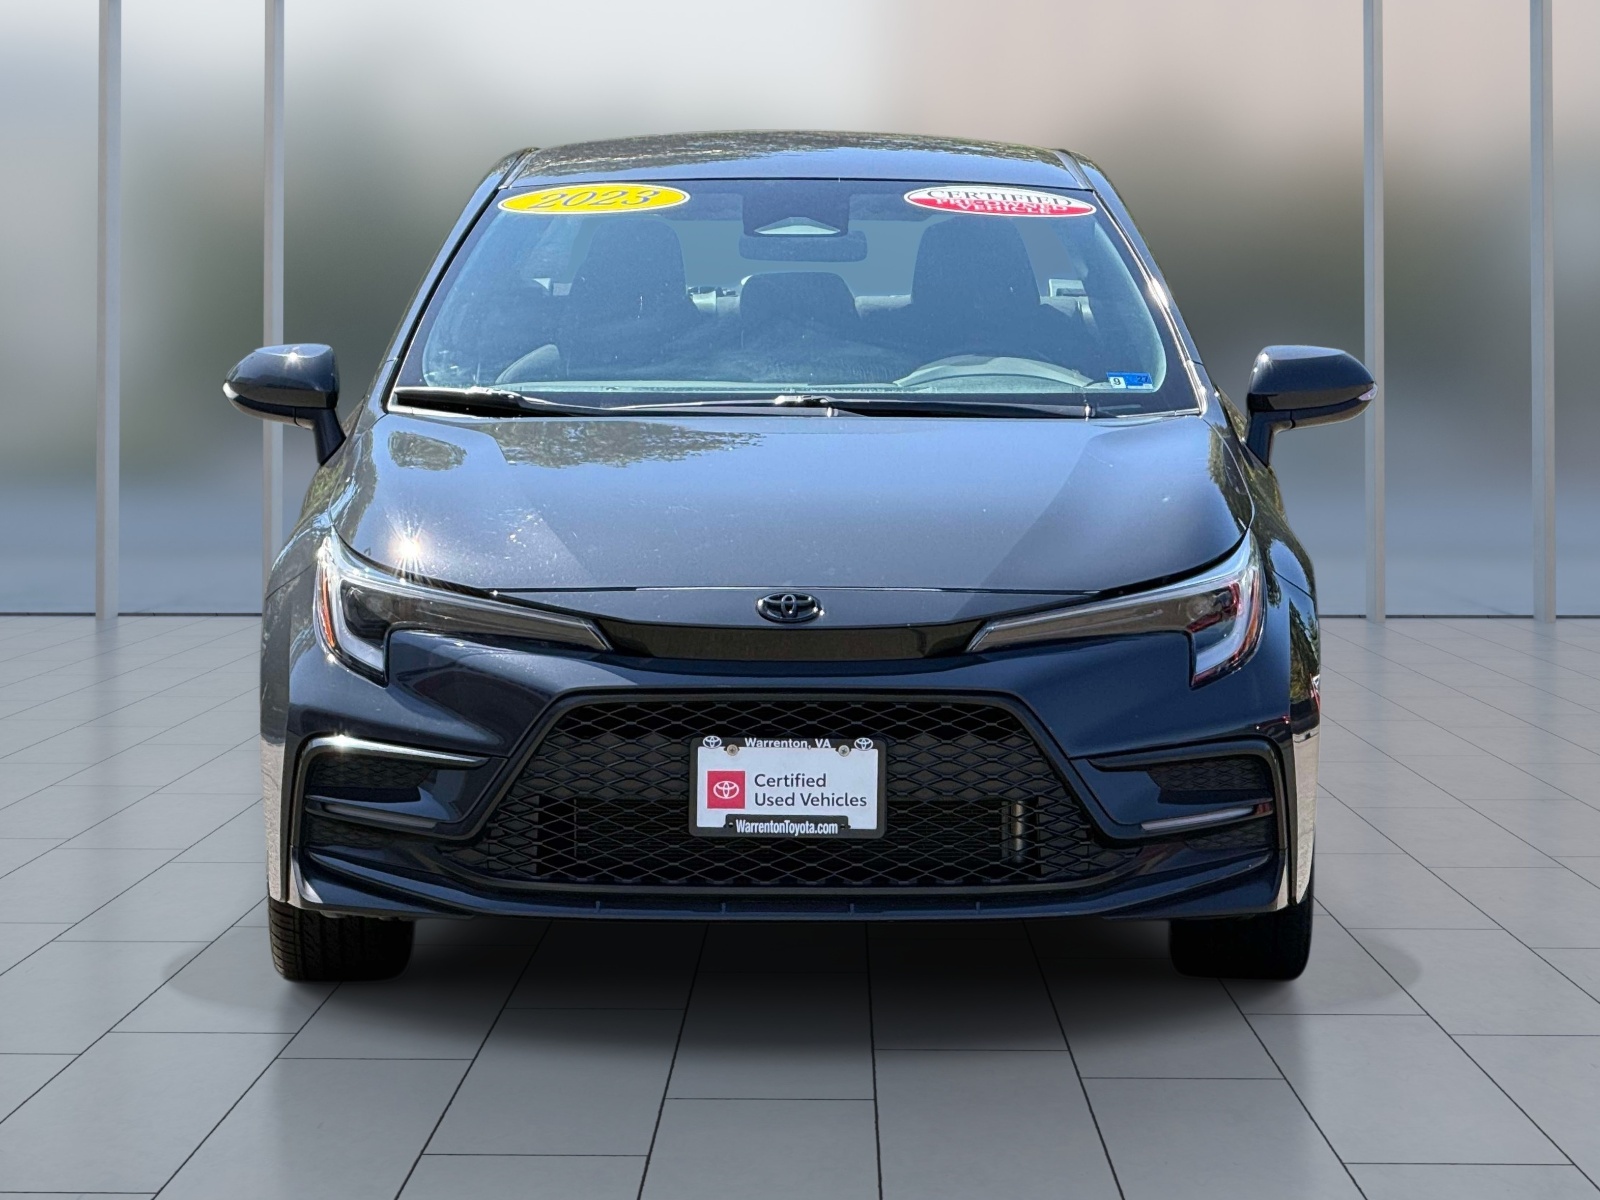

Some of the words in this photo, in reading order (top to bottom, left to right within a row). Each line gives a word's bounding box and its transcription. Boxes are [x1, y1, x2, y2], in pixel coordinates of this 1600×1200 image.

[528, 190, 660, 209] 2023
[927, 190, 1072, 206] CERTIFIED
[936, 199, 1068, 211] PRE-OWNED
[957, 203, 1051, 215] VEHICLE
[1113, 377, 1121, 386] 9
[744, 737, 812, 749] Warrenton,
[815, 738, 832, 749] VA
[754, 773, 827, 788] Certified
[754, 792, 795, 807] Used
[799, 792, 867, 807] Vehicles
[735, 819, 839, 836] WarrentonToyota.com
